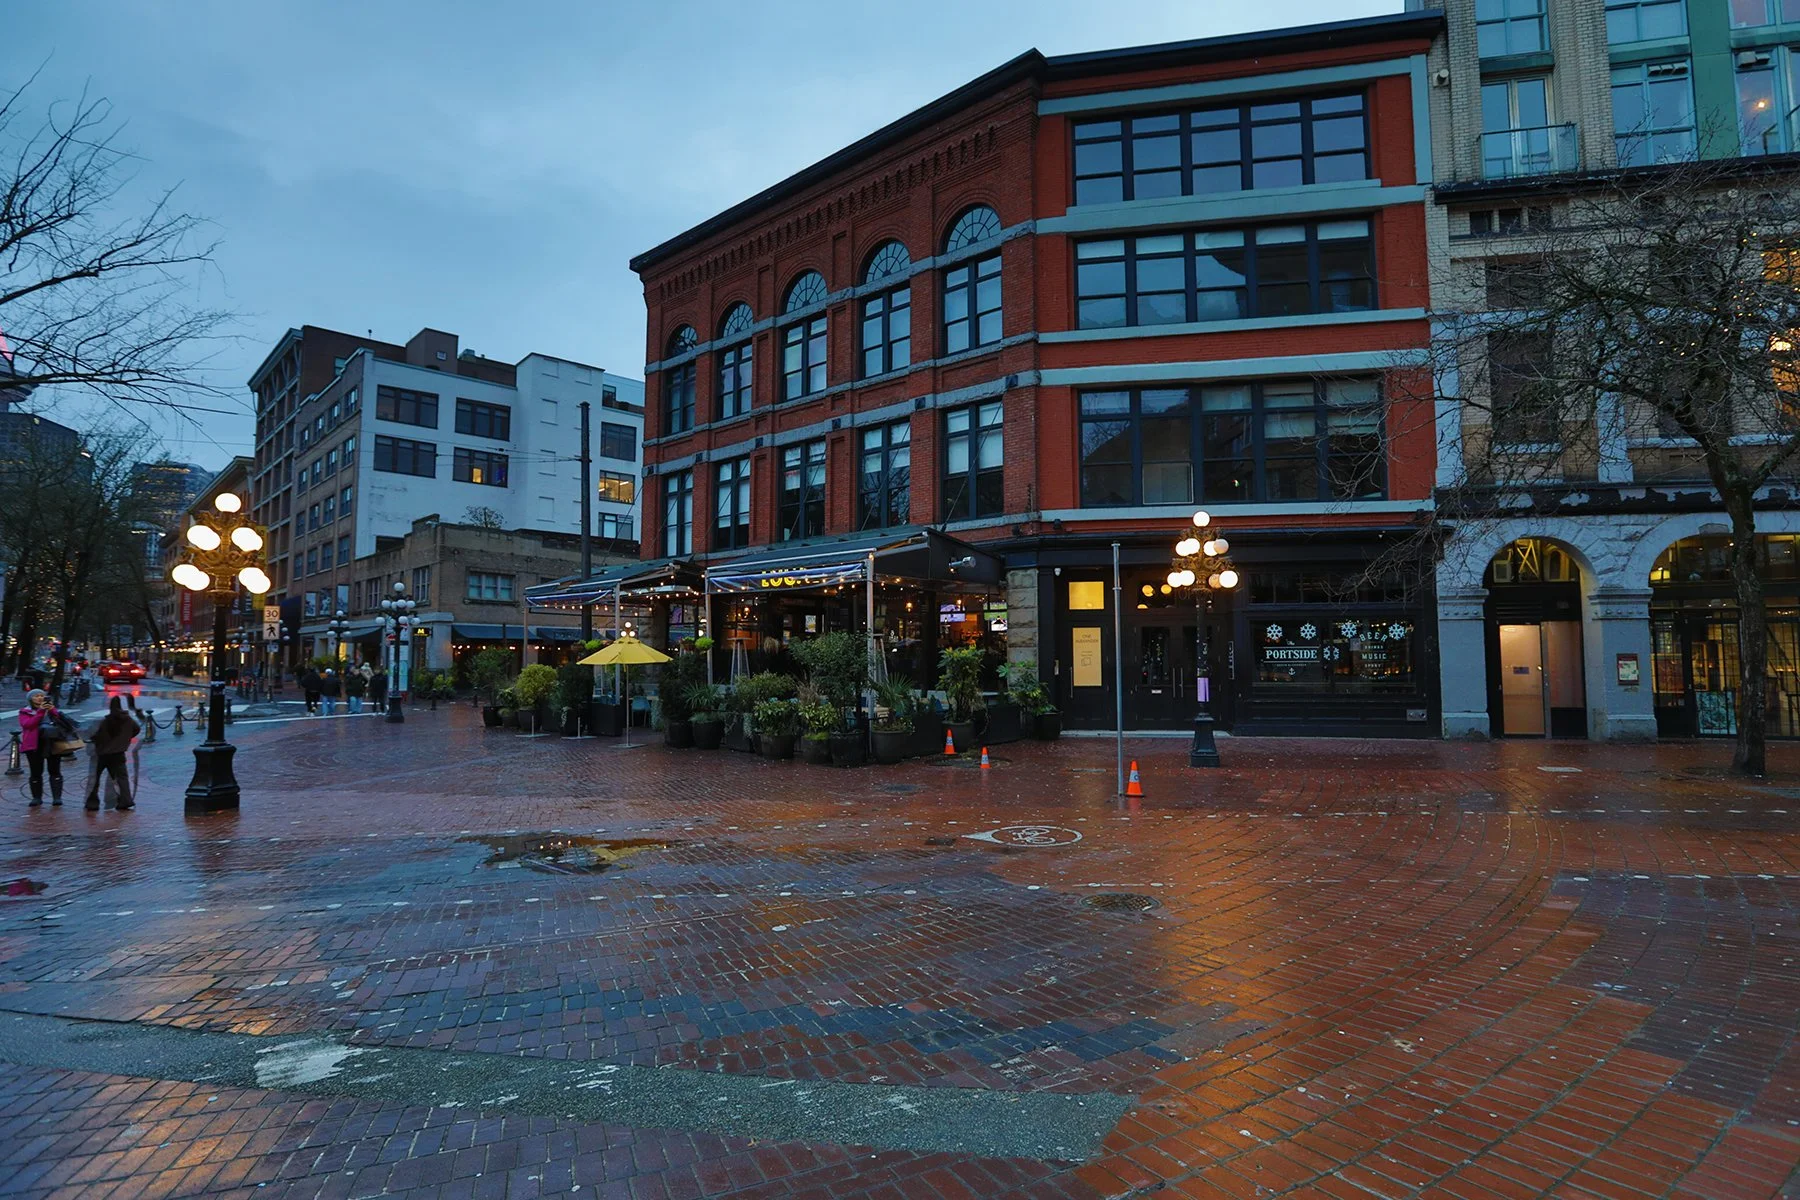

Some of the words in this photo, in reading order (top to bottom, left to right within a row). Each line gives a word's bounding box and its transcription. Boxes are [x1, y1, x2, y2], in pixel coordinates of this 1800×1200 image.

[266, 609, 278, 617] 30
[1359, 631, 1389, 643] BEER
[1265, 649, 1318, 660] PORTSIDE
